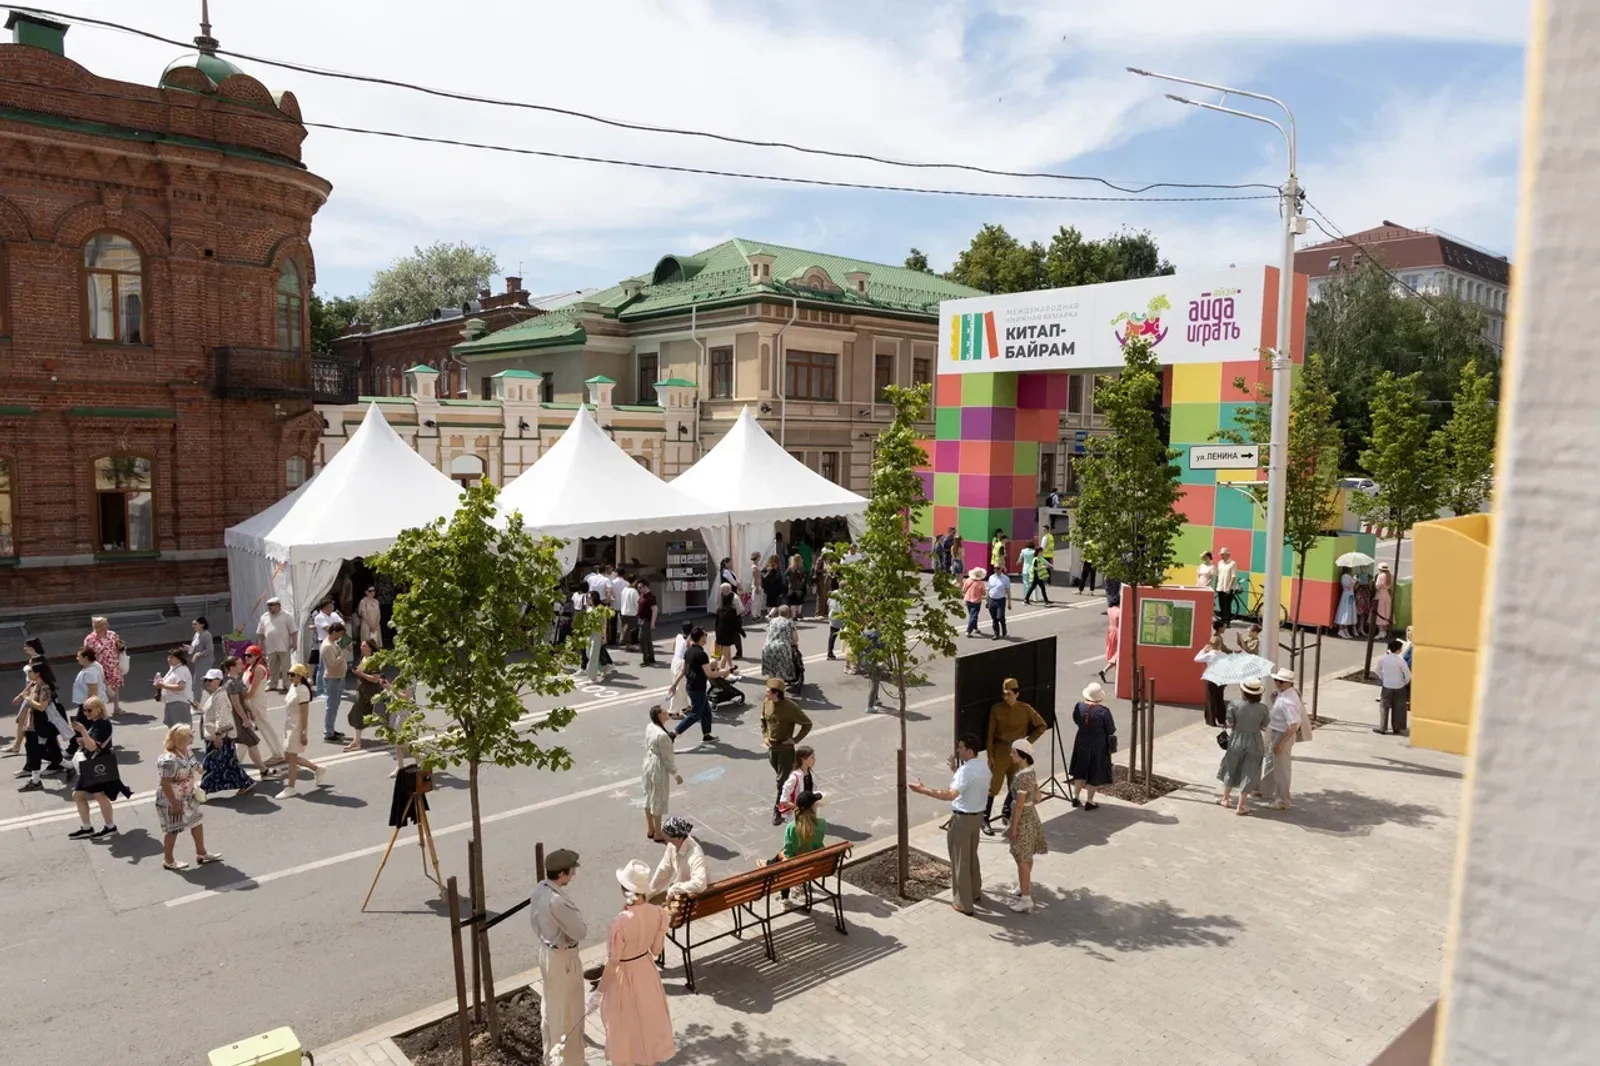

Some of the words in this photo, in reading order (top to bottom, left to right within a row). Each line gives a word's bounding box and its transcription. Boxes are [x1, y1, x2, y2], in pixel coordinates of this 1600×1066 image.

[1006, 302, 1080, 316] МЕЖДУНАРОДНАЯ
[1188, 292, 1235, 323] айда
[1005, 323, 1066, 341] КИТАП-
[1187, 321, 1241, 347] играть
[1005, 340, 1076, 359] БАЙРАМ
